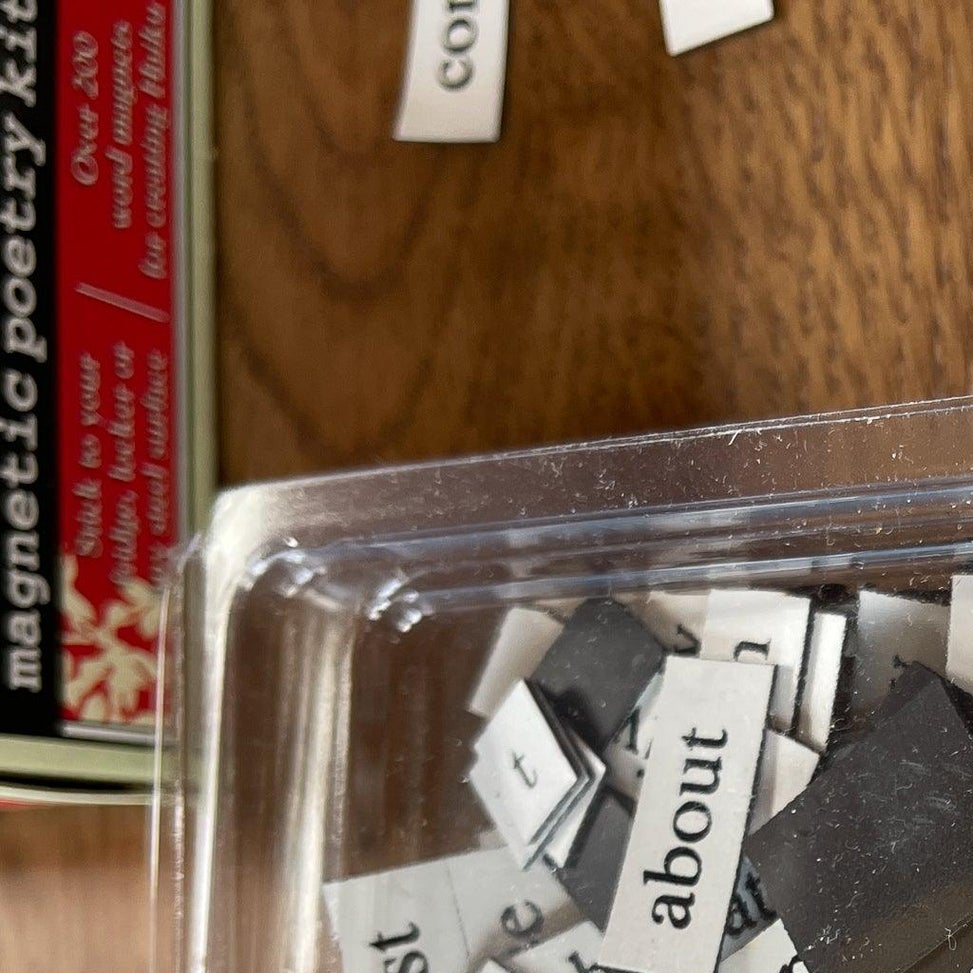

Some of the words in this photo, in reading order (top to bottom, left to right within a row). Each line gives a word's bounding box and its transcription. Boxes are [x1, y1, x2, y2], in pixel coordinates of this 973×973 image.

[0, 0, 38, 107] kit
[72, 31, 99, 98] 200
[111, 20, 138, 145] magnets
[438, 0, 479, 91] co
[71, 103, 99, 186] Over
[105, 146, 134, 229] word
[0, 112, 47, 363] poetry
[0, 370, 50, 693] magnetic
[643, 727, 728, 930] about
